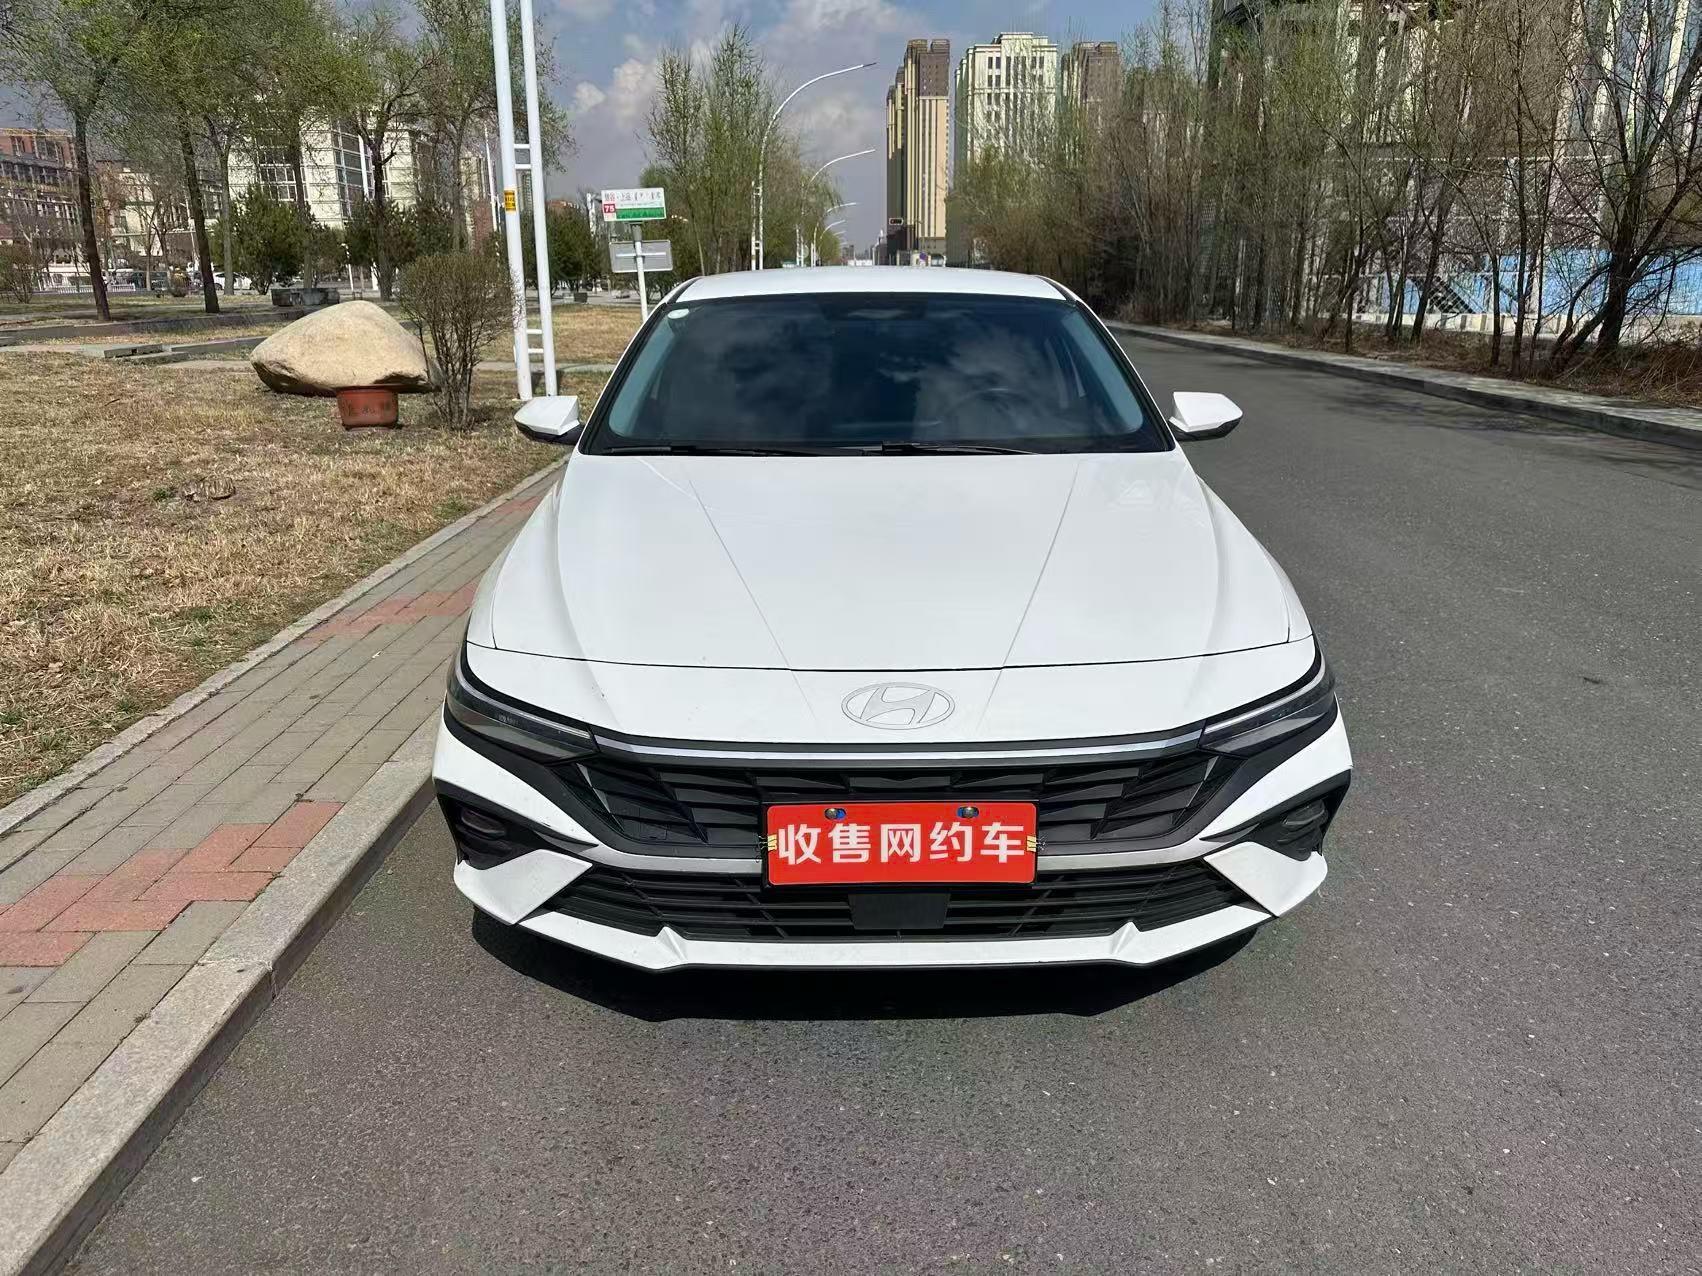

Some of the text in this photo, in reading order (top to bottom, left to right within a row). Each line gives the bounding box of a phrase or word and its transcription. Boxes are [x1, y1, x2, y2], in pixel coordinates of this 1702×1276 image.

[604, 205, 615, 213] 75
[778, 822, 1024, 865] 收售网约车
